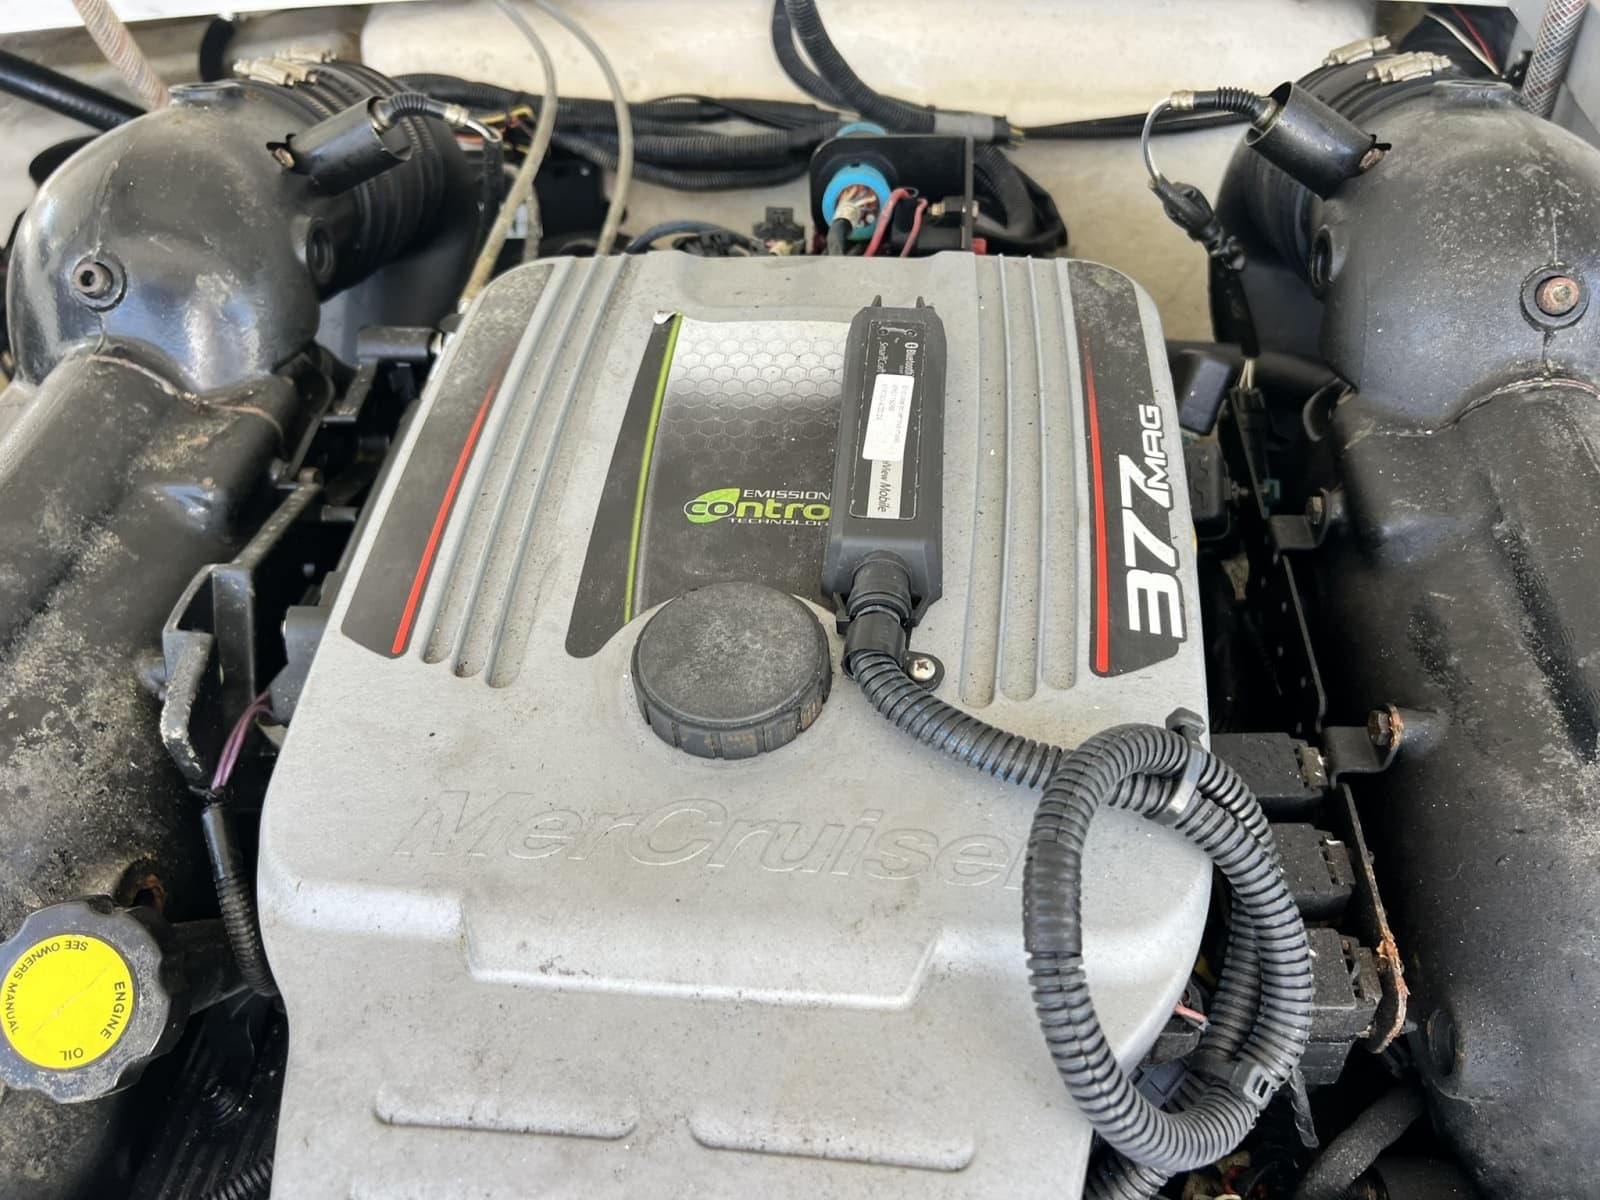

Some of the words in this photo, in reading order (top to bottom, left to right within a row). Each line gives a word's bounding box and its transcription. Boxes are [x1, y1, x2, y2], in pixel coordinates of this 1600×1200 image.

[1138, 404, 1169, 490] MAG
[683, 498, 831, 521] contro
[743, 489, 831, 500] EMISSION
[877, 482, 892, 513] Mobile
[1118, 454, 1184, 639] 377
[13, 942, 61, 980] OWNERS
[64, 940, 89, 952] SEE
[5, 982, 20, 1035] MANUAL
[100, 981, 126, 1040] ENGINE
[59, 1047, 84, 1061] OIL
